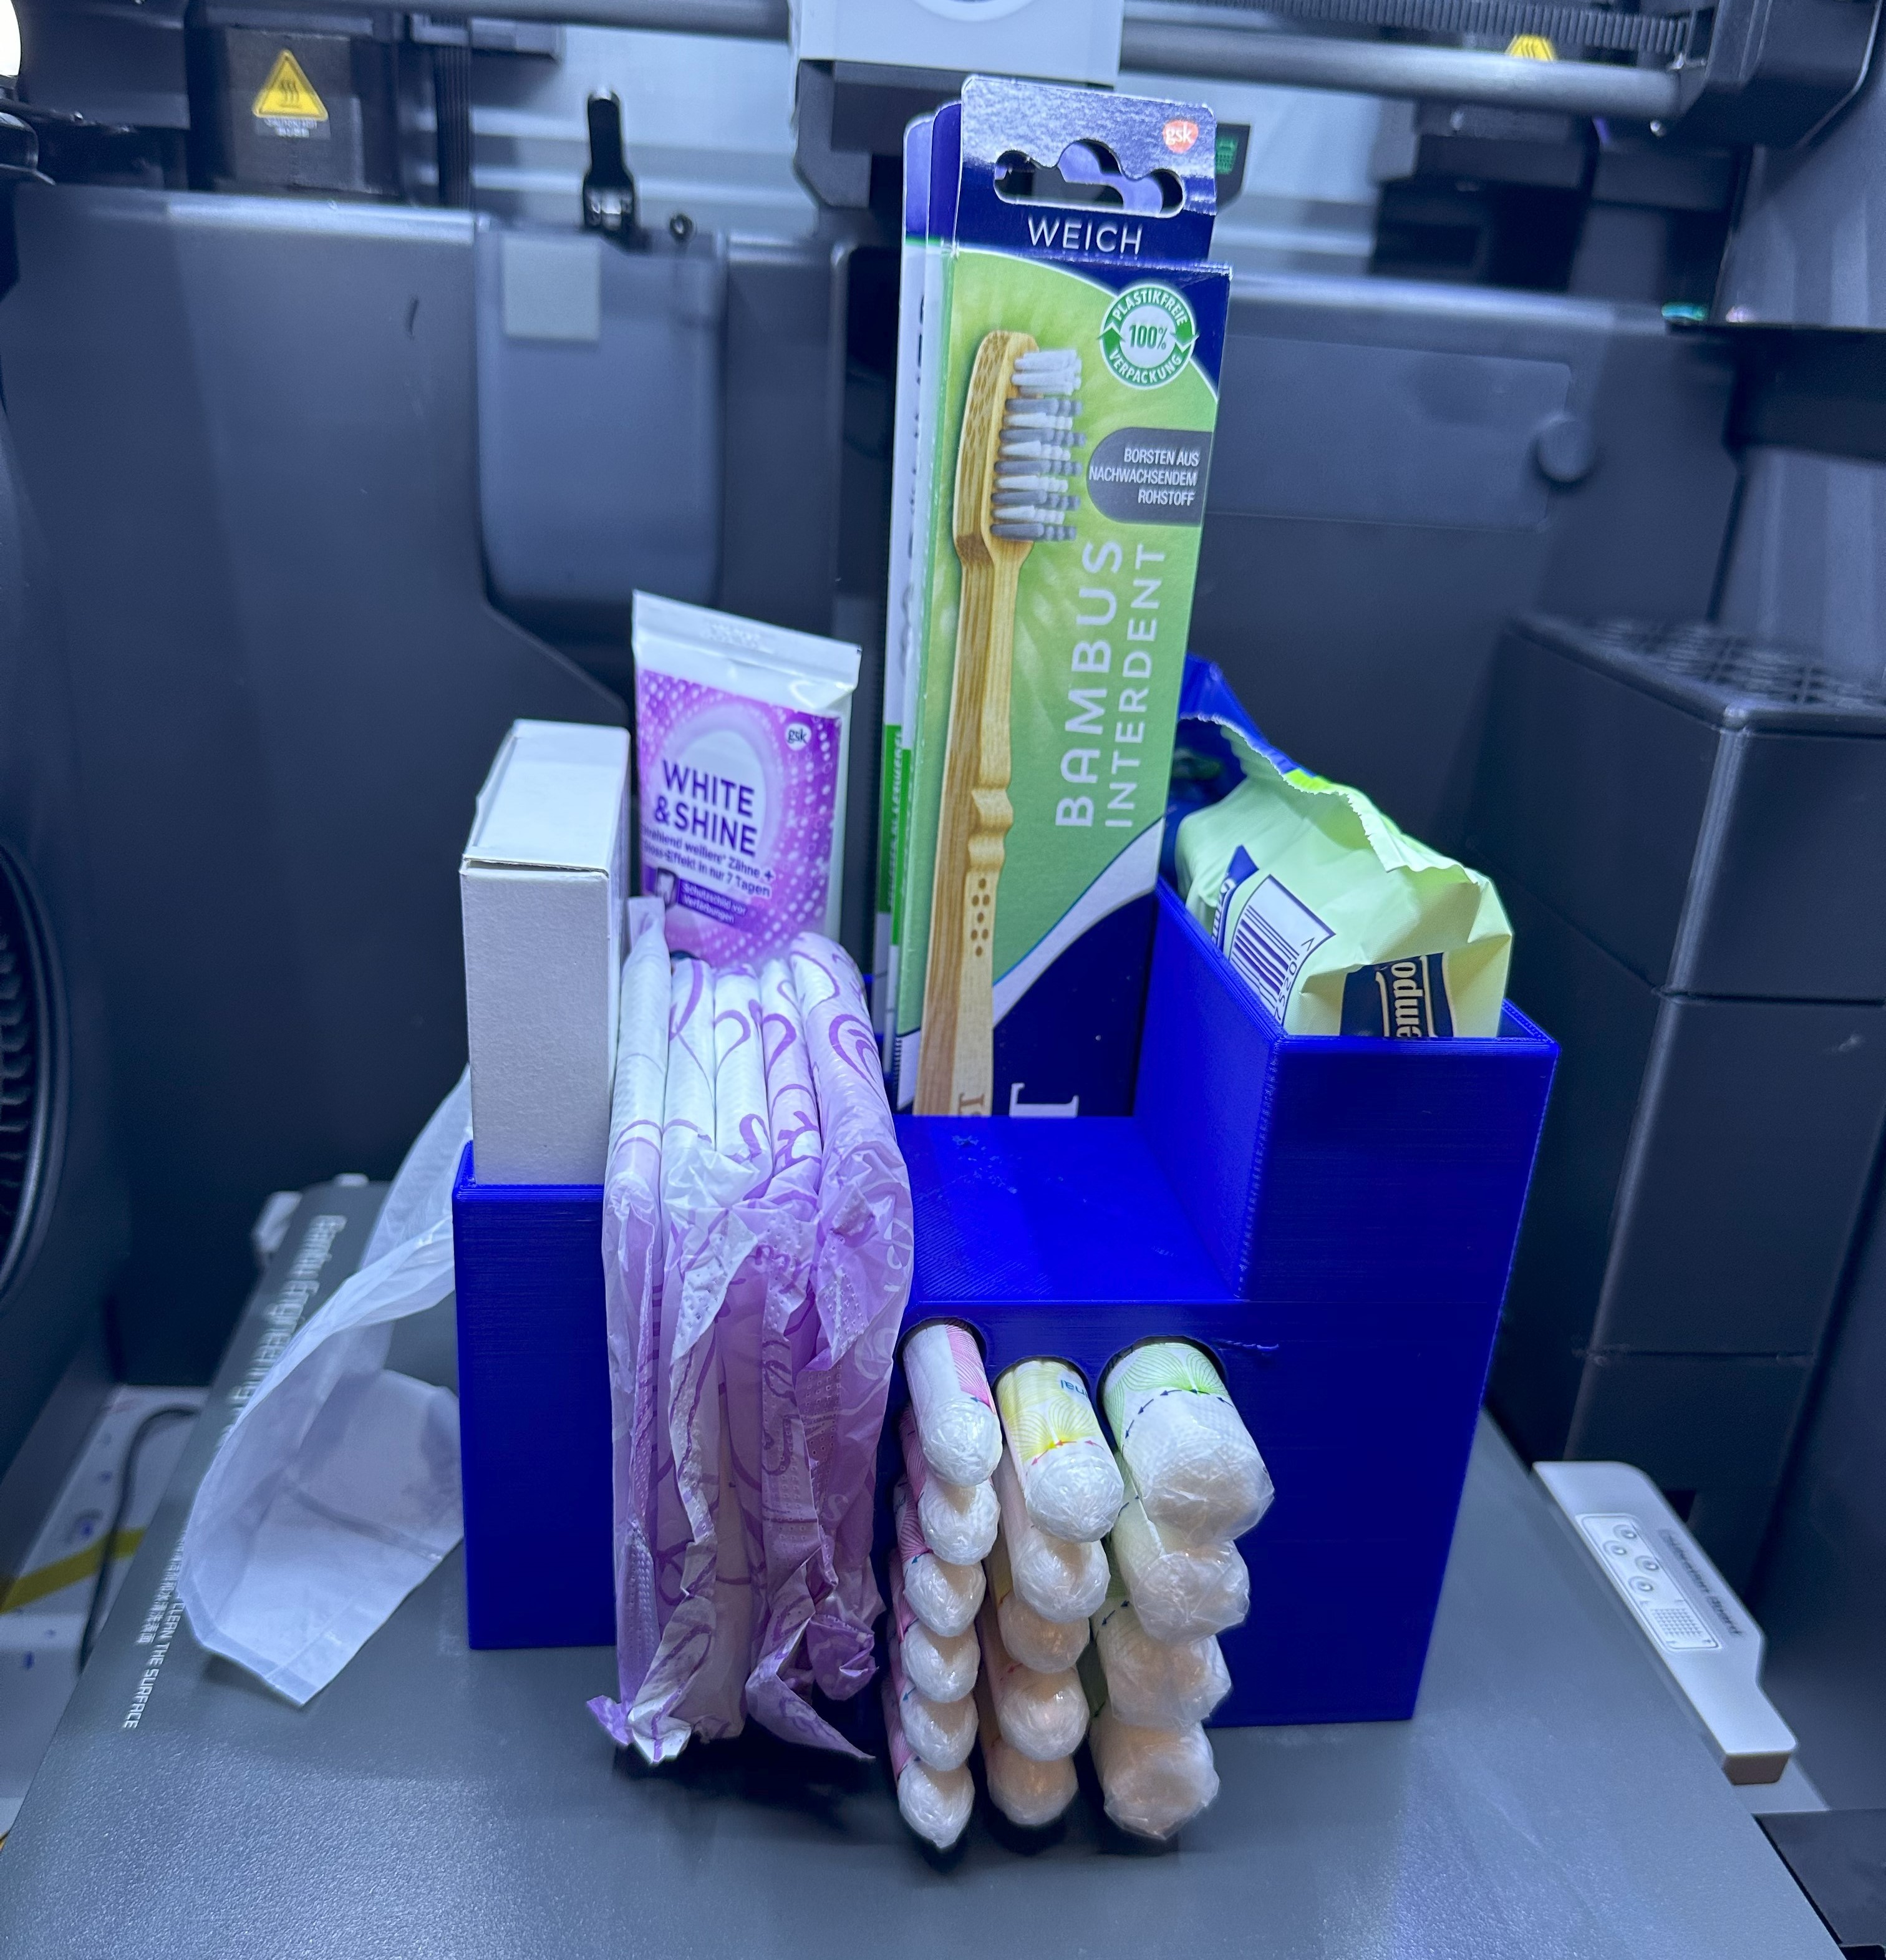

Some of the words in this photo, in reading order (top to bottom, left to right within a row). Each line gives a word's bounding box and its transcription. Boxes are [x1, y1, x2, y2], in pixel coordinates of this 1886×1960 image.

[1164, 122, 1192, 145] gsk
[1028, 216, 1143, 255] WEICH
[1112, 289, 1188, 326] PLASTIKFREIE
[1128, 324, 1168, 351] 100%
[1109, 349, 1182, 384] VERPACKUNG
[1124, 447, 1175, 465] BORSTEN
[1176, 450, 1201, 467] AUS
[1089, 465, 1198, 487] NACHWACHSENDEM
[1138, 488, 1196, 507] ROHSTOFF
[1055, 540, 1124, 827] BAMBUS
[1105, 543, 1166, 828] INTERDENT
[787, 729, 808, 745] gsk
[662, 759, 755, 818] WHITE
[728, 856, 761, 877] Zähne
[735, 874, 770, 898] Tagen
[148, 1641, 171, 1667] THE
[123, 1667, 160, 1730] SURFACE
